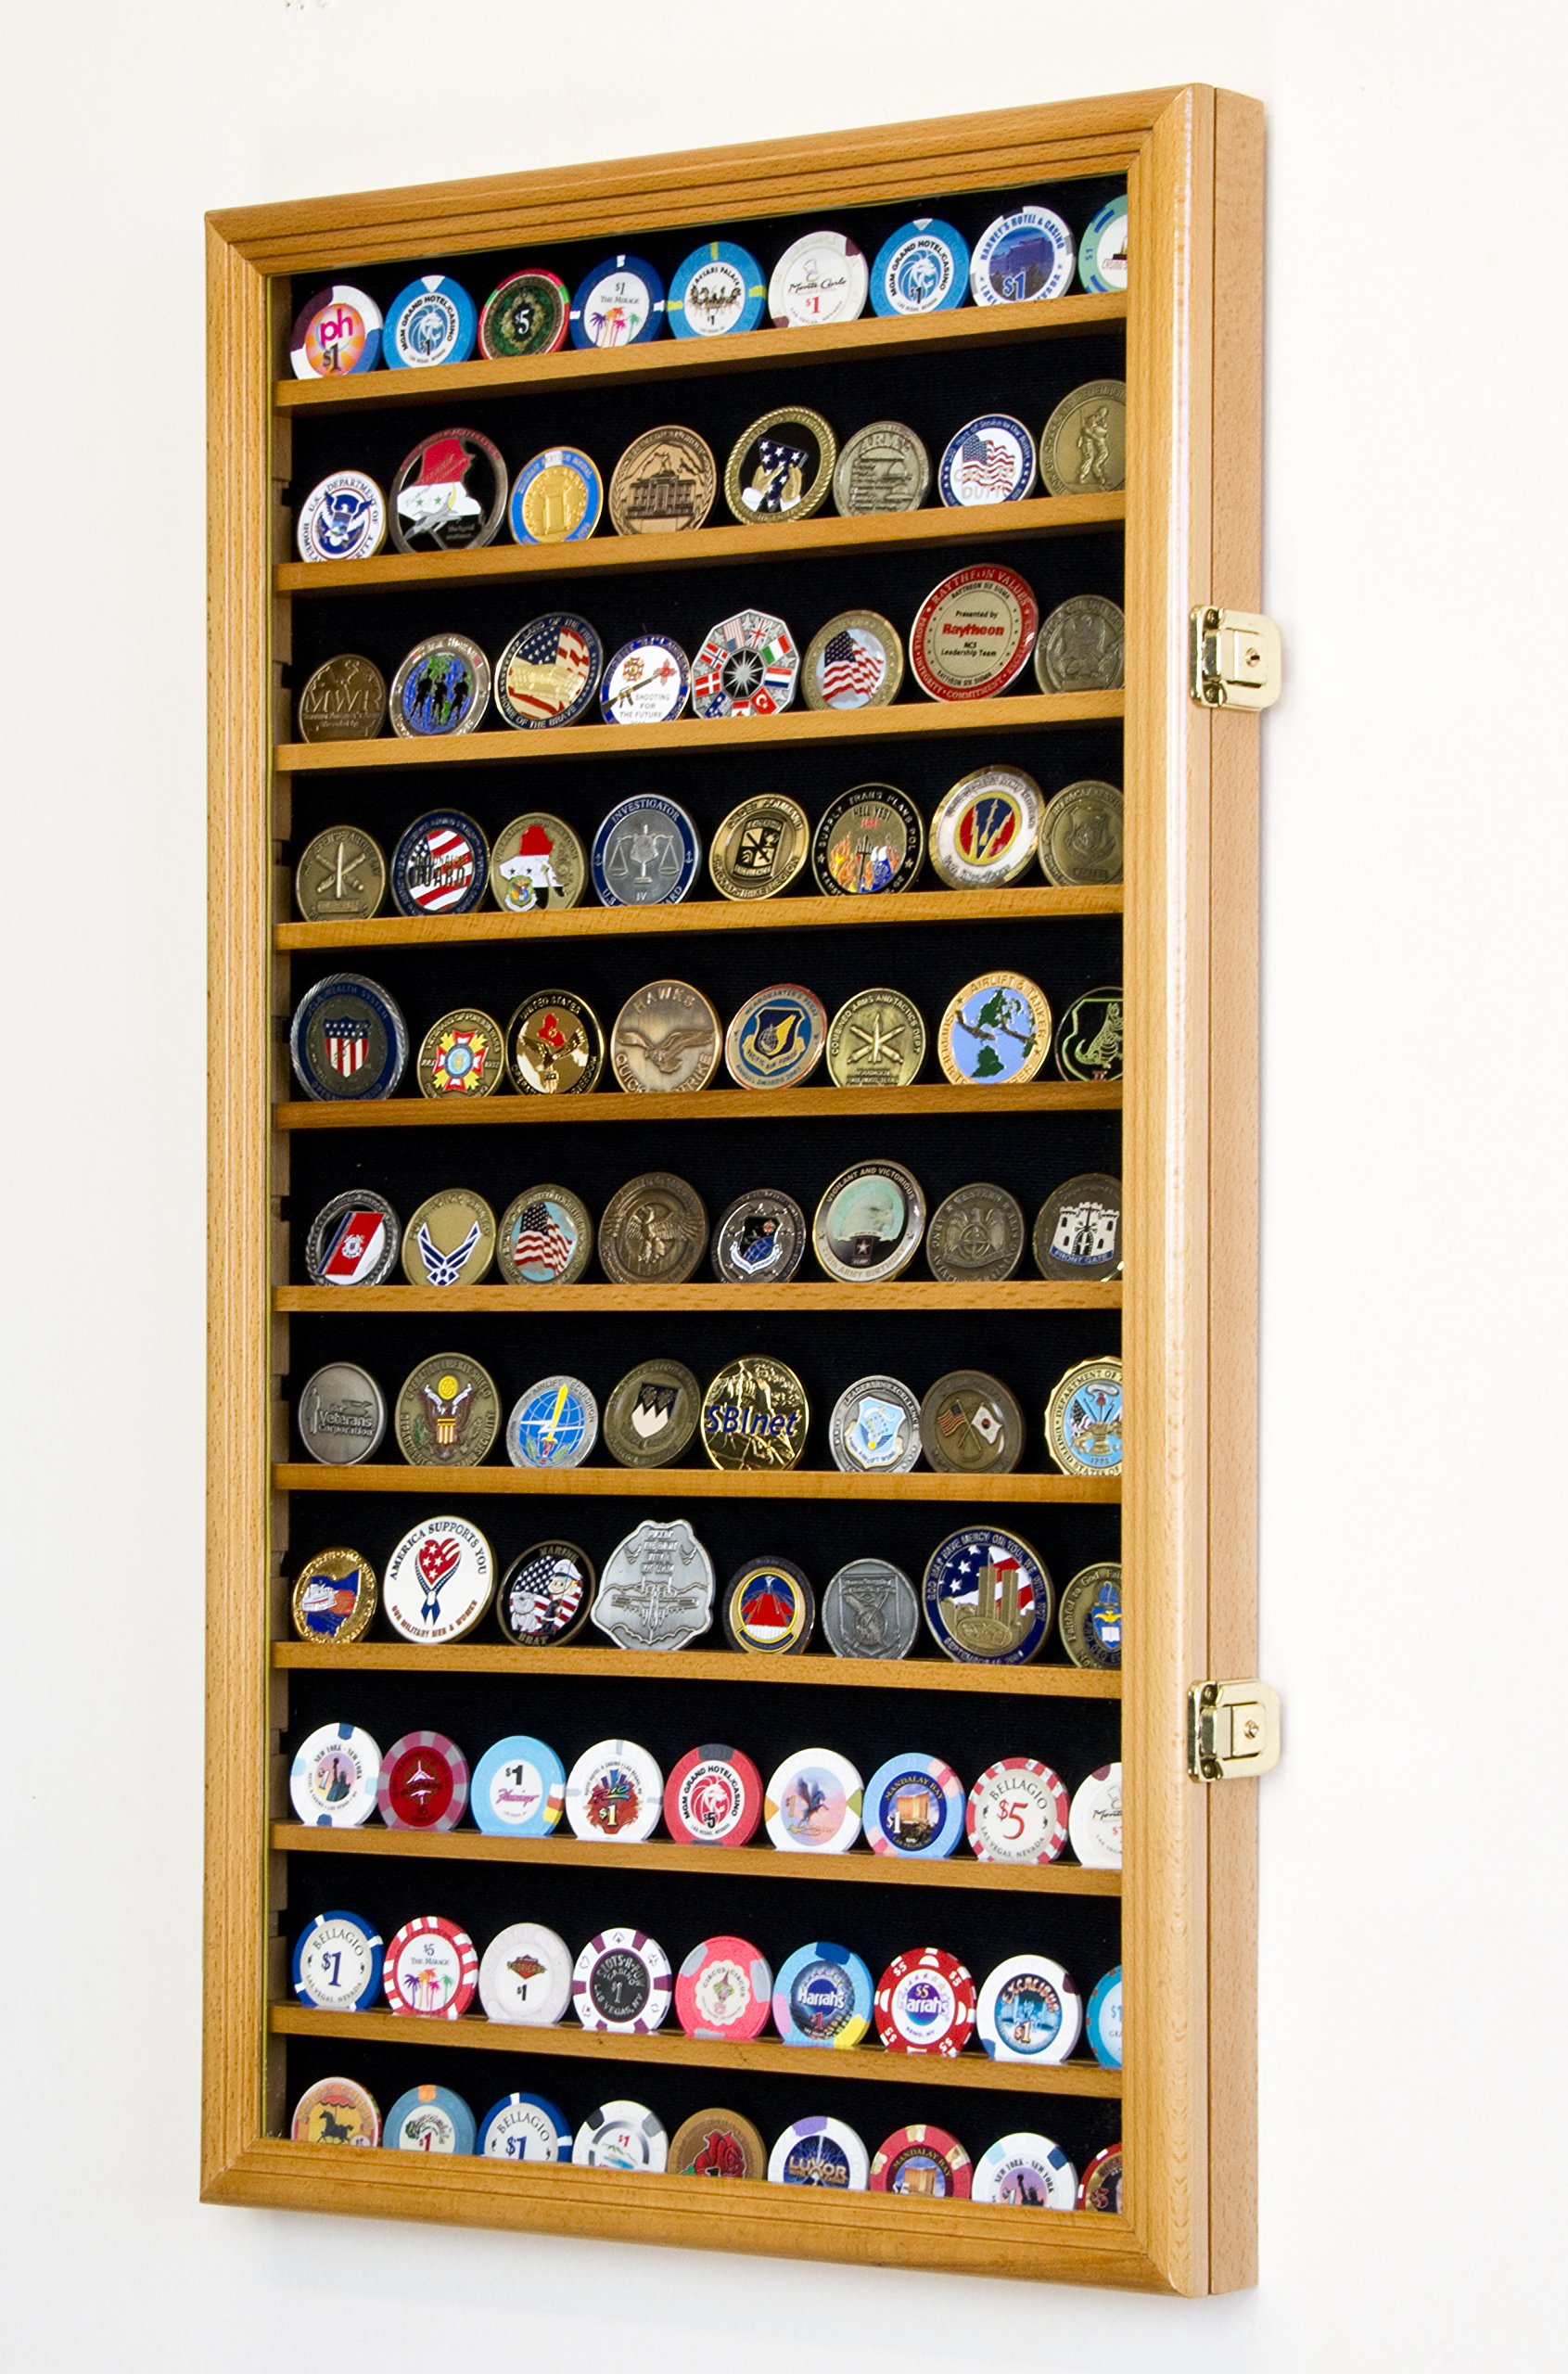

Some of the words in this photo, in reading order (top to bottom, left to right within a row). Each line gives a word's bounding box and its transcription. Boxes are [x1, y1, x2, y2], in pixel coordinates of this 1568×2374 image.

[980, 222, 1011, 261] HARVEY'S
[1011, 214, 1036, 227] HOTEL
[1044, 220, 1065, 249] CASINO
[893, 242, 916, 273] GRAND
[615, 282, 626, 295] $1
[820, 276, 848, 288] Carlo
[1002, 272, 1026, 300] $1
[601, 295, 613, 303] THE
[613, 296, 640, 305] MIRAGE
[805, 296, 821, 315] $1
[910, 287, 922, 304] $1
[402, 299, 424, 327] GRAND
[515, 309, 529, 334] $5
[320, 309, 353, 347] ph
[397, 329, 408, 351] MGM
[322, 343, 342, 372] $1
[419, 338, 432, 356] $1
[860, 431, 911, 454] ARMY
[326, 479, 376, 507] DEPARTMENT
[372, 510, 379, 525] OF
[933, 569, 996, 604] RAYTHEON
[997, 571, 1031, 606] VALUES
[951, 581, 983, 599] RAYTHEON
[994, 585, 1011, 600] SIGMA
[955, 610, 988, 619] Presented
[989, 610, 999, 619] by
[523, 621, 546, 638] LAND
[549, 617, 562, 625] OF
[564, 619, 580, 630] THE
[580, 627, 595, 646] FREE
[914, 616, 928, 650] PEOPLE
[942, 623, 1005, 638] Raytheon
[941, 649, 978, 657] Leadership
[915, 655, 944, 693] INTEGRITY
[635, 693, 670, 701] SHOOTING
[947, 676, 1004, 700] COMMITMENT
[304, 689, 381, 713] MWR
[499, 696, 517, 720] HOME
[516, 717, 529, 726] OF
[529, 719, 546, 729] THE
[548, 705, 577, 726] BRAVE
[635, 710, 662, 719] FUTURE
[611, 797, 681, 824] INVESTIGATOR
[726, 801, 759, 829] CADET
[762, 798, 804, 831] COMMAND
[817, 807, 844, 848] SUPPLY
[848, 790, 883, 804] TRANS
[887, 795, 912, 823] PLANS
[853, 805, 871, 818] HELL
[635, 892, 647, 901] IV
[325, 985, 358, 999] HEALTH
[361, 990, 389, 1020] SYSTEM
[519, 997, 549, 1020] UNITED
[551, 996, 581, 1015] STATES
[634, 987, 695, 1014] HAWKS
[969, 975, 1014, 994] AIRLIFT
[1027, 984, 1047, 1038] TANKER
[426, 1015, 454, 1049] VETERANS
[465, 1013, 491, 1033] FOREIGN
[831, 1009, 853, 1055] COMBINED
[852, 996, 875, 1011] ARMS
[875, 995, 893, 1003] AND
[893, 999, 917, 1026] TACTICS
[826, 1174, 858, 1202] VIGILANT
[859, 1167, 877, 1176] AND
[877, 1167, 915, 1201] VICTORIOUS
[953, 1188, 1001, 1204] WESTERN
[1053, 1250, 1083, 1263] FRONT
[1084, 1254, 1108, 1264] GATE
[406, 1359, 442, 1399] OPERATION
[569, 1381, 595, 1423] SQUADRON
[887, 1383, 920, 1431] EXCELLENCE
[1056, 1370, 1102, 1420] DEPARTMENT
[1104, 1370, 1116, 1379] OF
[317, 1424, 374, 1437] Corporation
[318, 1409, 374, 1428] Veterans
[707, 1402, 801, 1437] SBInet
[473, 1411, 495, 1458] SECURITY
[1055, 1426, 1075, 1463] UNITED
[1073, 1459, 1105, 1476] STATES
[389, 1530, 426, 1580] AMERICA
[427, 1521, 480, 1549] SUPPORTS
[474, 1547, 488, 1576] YOU
[942, 1538, 962, 1559] HAVE
[961, 1532, 990, 1545] MERCY
[539, 1546, 580, 1564] MARINE
[930, 1557, 944, 1577] MAY
[1024, 1558, 1037, 1573] WE
[927, 1580, 937, 1601] GOD
[1031, 1575, 1046, 1600] WILL
[1065, 1600, 1077, 1642] Faithful
[1079, 1571, 1100, 1587] God
[391, 1605, 402, 1623] OUR
[401, 1621, 430, 1639] MILITARY
[431, 1627, 447, 1639] MEN
[455, 1599, 478, 1628] WOMEN
[517, 1632, 550, 1645] BRAT
[317, 1768, 330, 1791] $1
[505, 1764, 524, 1786] $1
[684, 1768, 707, 1794] GRAND
[495, 1788, 540, 1806] Flamingo
[885, 1775, 930, 1801] MANDALAY
[929, 1781, 945, 1800] BAY
[989, 1778, 1048, 1810] BELLAGIO
[599, 1804, 618, 1827] $1
[682, 1796, 690, 1819] MGM
[785, 1794, 797, 1818] $1
[703, 1811, 717, 1829] $5
[886, 1809, 901, 1833] $1
[997, 1798, 1028, 1840] $5
[981, 1826, 990, 1844] LAS
[1016, 1836, 1046, 1857] NEVADA
[312, 1927, 363, 1958] BELLAGIO
[424, 1943, 435, 1956] $5
[321, 1951, 342, 1987] $1
[411, 1957, 424, 1965] THE
[425, 1957, 450, 1965] MIRAGE
[893, 1962, 908, 1977] $5
[306, 1974, 316, 1991] LAS
[338, 1982, 363, 2003] NEVADA
[606, 1967, 640, 1986] CASINO
[702, 1968, 728, 1988] CIRCUS
[730, 1969, 746, 1998] CIRCUS
[949, 1971, 962, 1987] $5
[516, 1985, 527, 2001] $1
[593, 1984, 605, 2002] LAS
[611, 1981, 622, 2003] $1
[915, 1985, 930, 1999] $5
[1002, 1976, 1060, 2013] EXCALIBUR
[810, 2011, 823, 2031] $1
[1014, 2021, 1031, 2044] $1
[884, 2026, 898, 2044] $5
[939, 2036, 953, 2052] $5
[496, 2111, 550, 2141] BELLAGIO
[419, 2132, 432, 2151] $1
[505, 2136, 528, 2159] $1
[618, 2134, 631, 2148] $1
[788, 2155, 848, 2176] LUXOR
[894, 2147, 938, 2169] MANDALAY
[937, 2159, 952, 2177] BAY
[994, 2167, 1006, 2183] NEW
[1006, 2159, 1025, 2171] YORK
[1031, 2160, 1044, 2174] NEW
[1043, 2172, 1056, 2194] YORK
